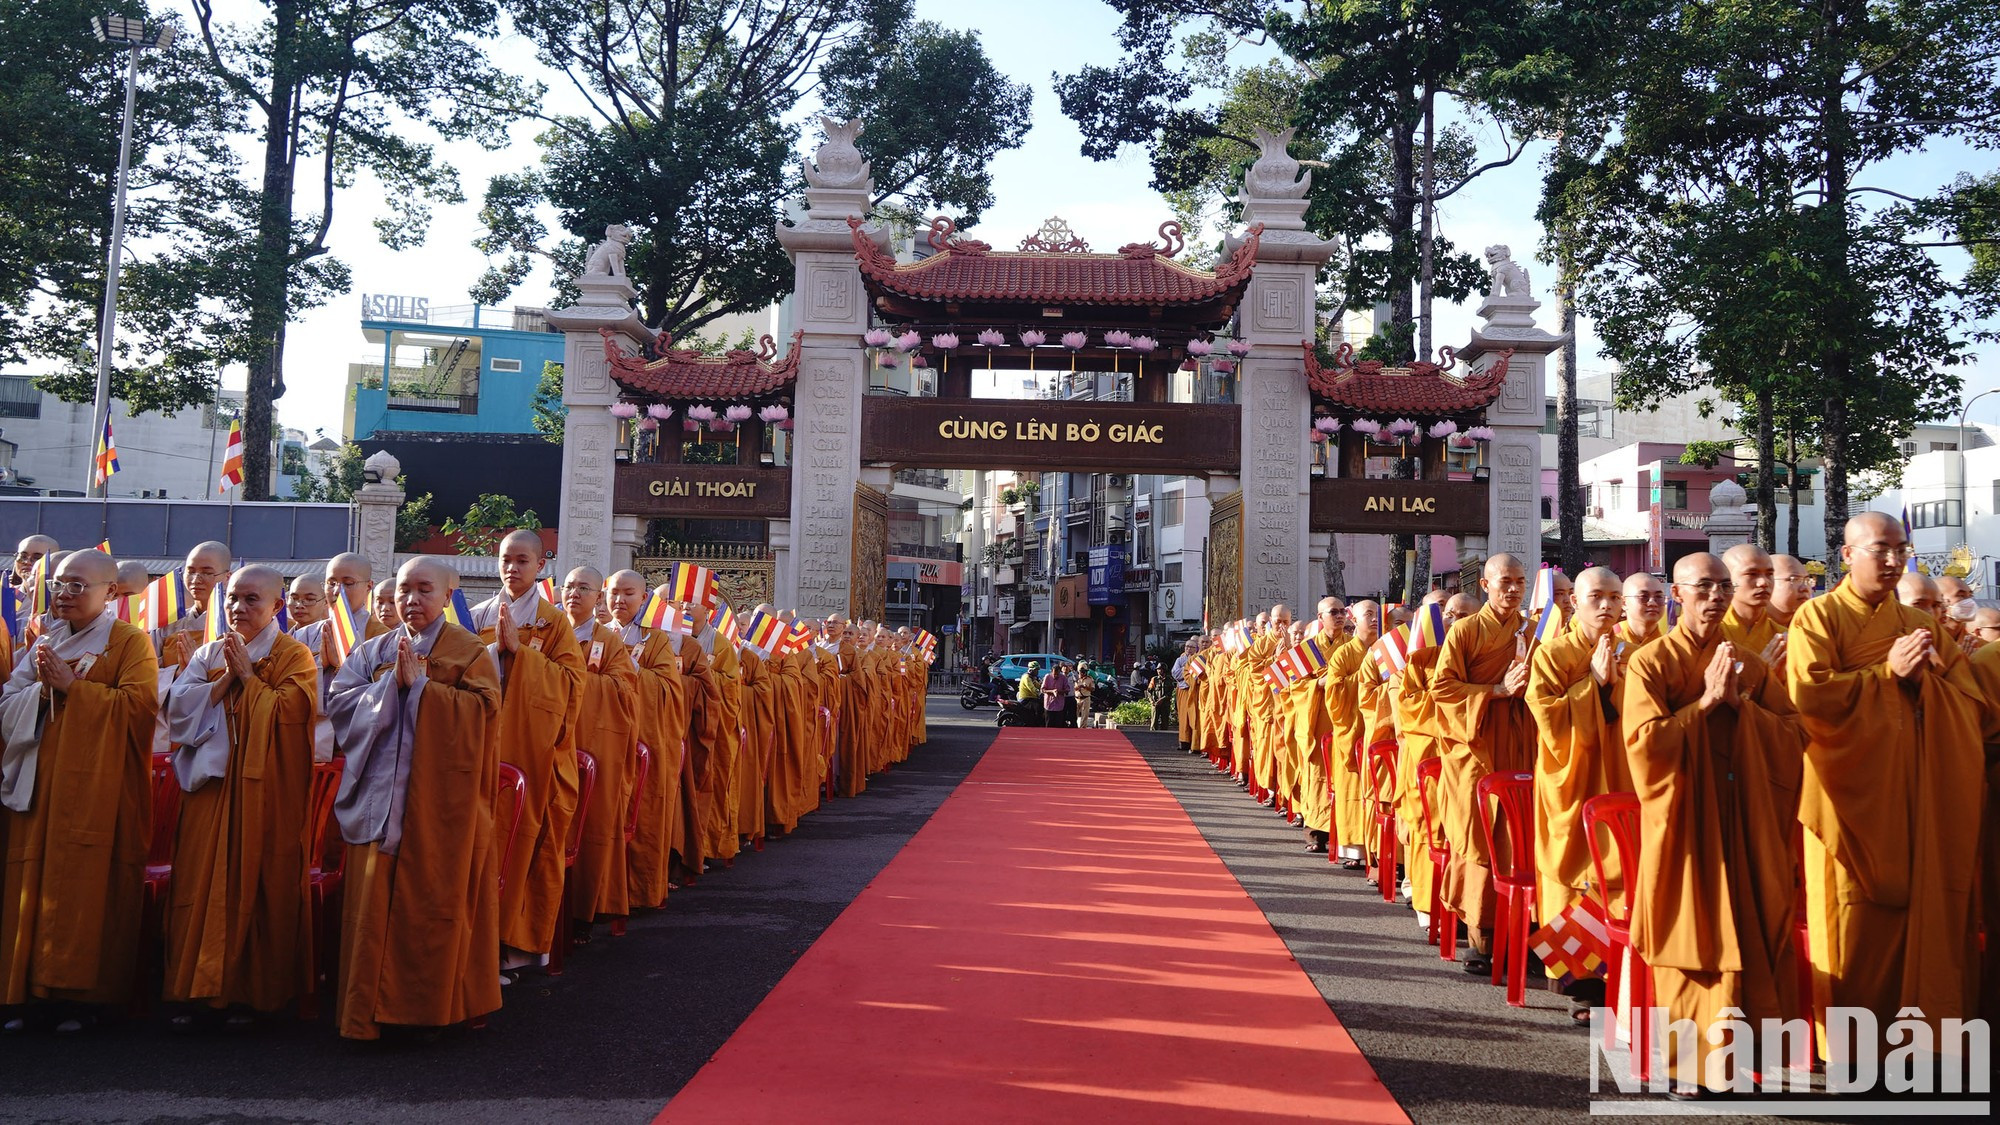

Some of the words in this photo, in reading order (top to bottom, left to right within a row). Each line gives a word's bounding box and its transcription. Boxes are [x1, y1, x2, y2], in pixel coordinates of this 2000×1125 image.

[1263, 380, 1289, 394] Vào
[813, 403, 847, 419] Việt
[810, 420, 847, 434] Nam
[938, 415, 1008, 440] CÙNG
[1016, 417, 1057, 441] LÊN
[1066, 418, 1101, 442] BỜ
[1108, 419, 1164, 444] GIÁC
[1260, 412, 1294, 431] Quốc
[648, 476, 690, 496] GIẢI
[695, 478, 757, 498] THOÁT
[1364, 496, 1395, 512] AN
[1402, 497, 1436, 517] LẠC
[1259, 516, 1291, 533] Sáng
[1257, 550, 1291, 565] Chân
